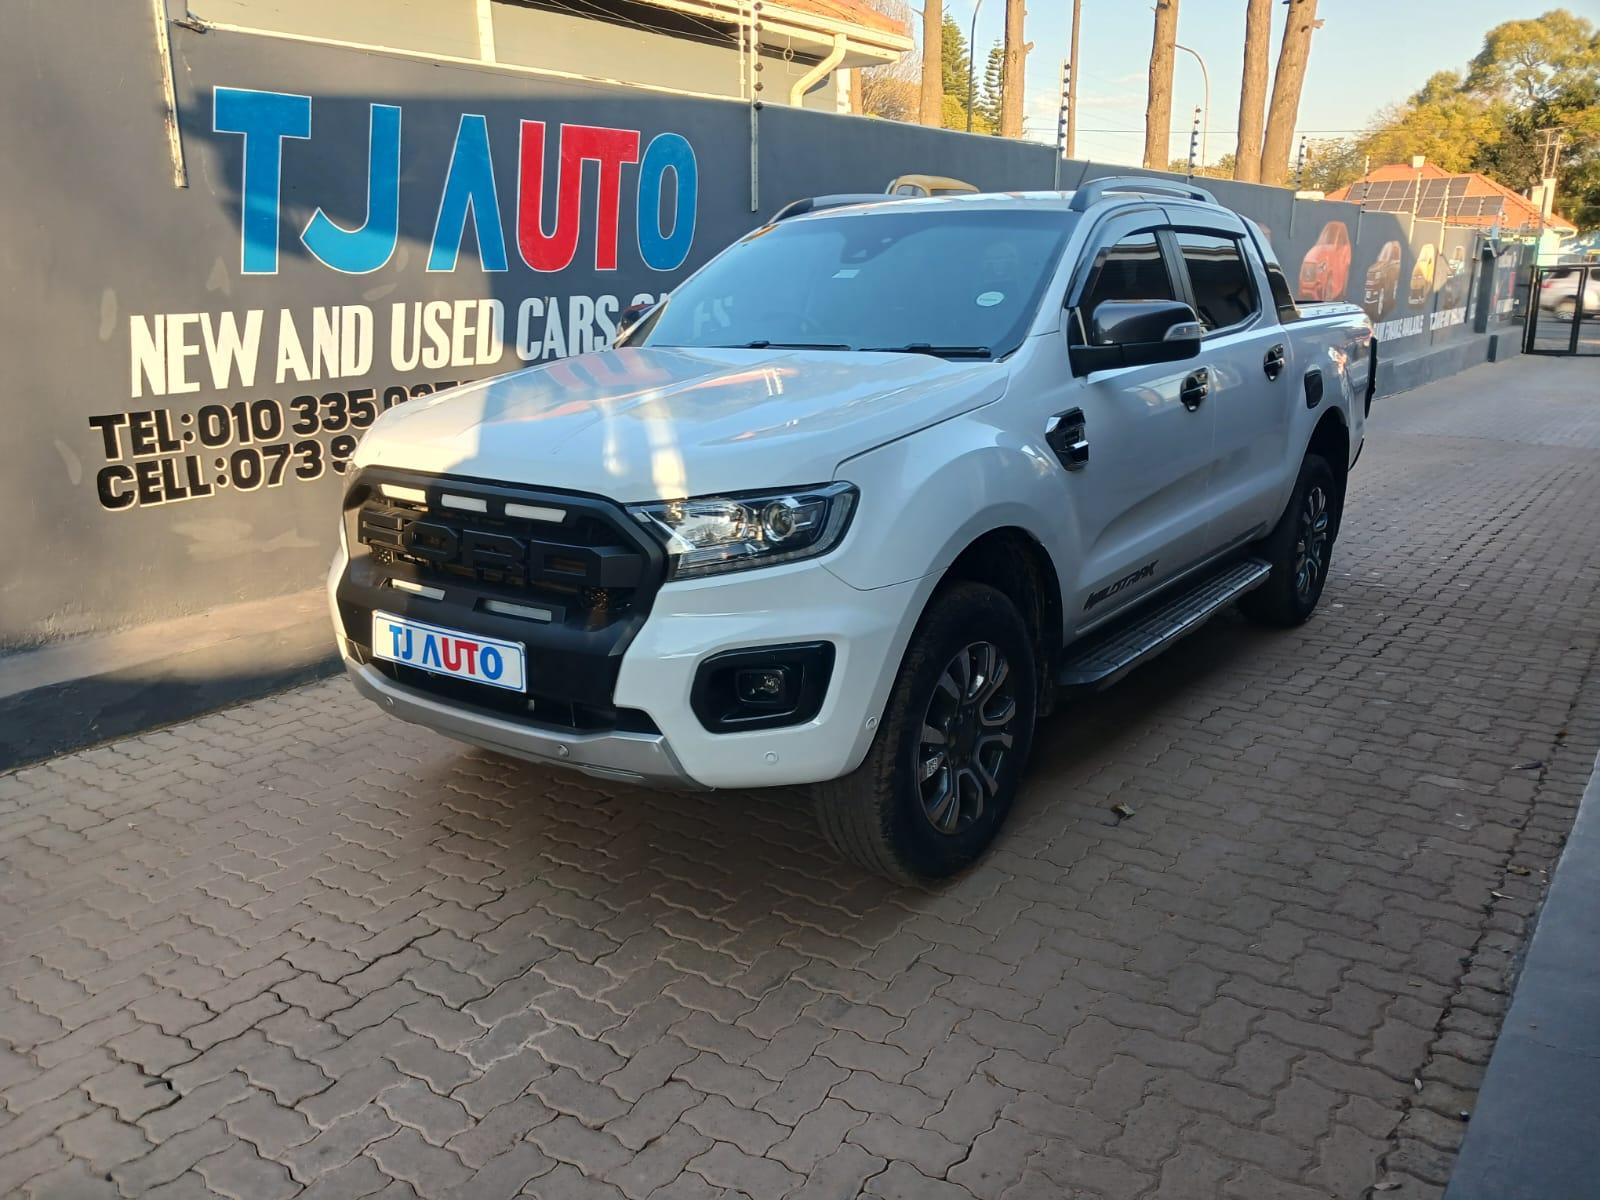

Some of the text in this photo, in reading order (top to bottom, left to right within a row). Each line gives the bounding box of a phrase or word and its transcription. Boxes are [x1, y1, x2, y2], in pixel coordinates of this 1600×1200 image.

[213, 86, 699, 275] TJ AUTO
[130, 309, 264, 398] NEW
[275, 304, 374, 384] AND
[390, 298, 505, 373] USED
[516, 294, 620, 361] CARS
[290, 388, 378, 438] 335
[389, 624, 504, 680] TJ AUTO
